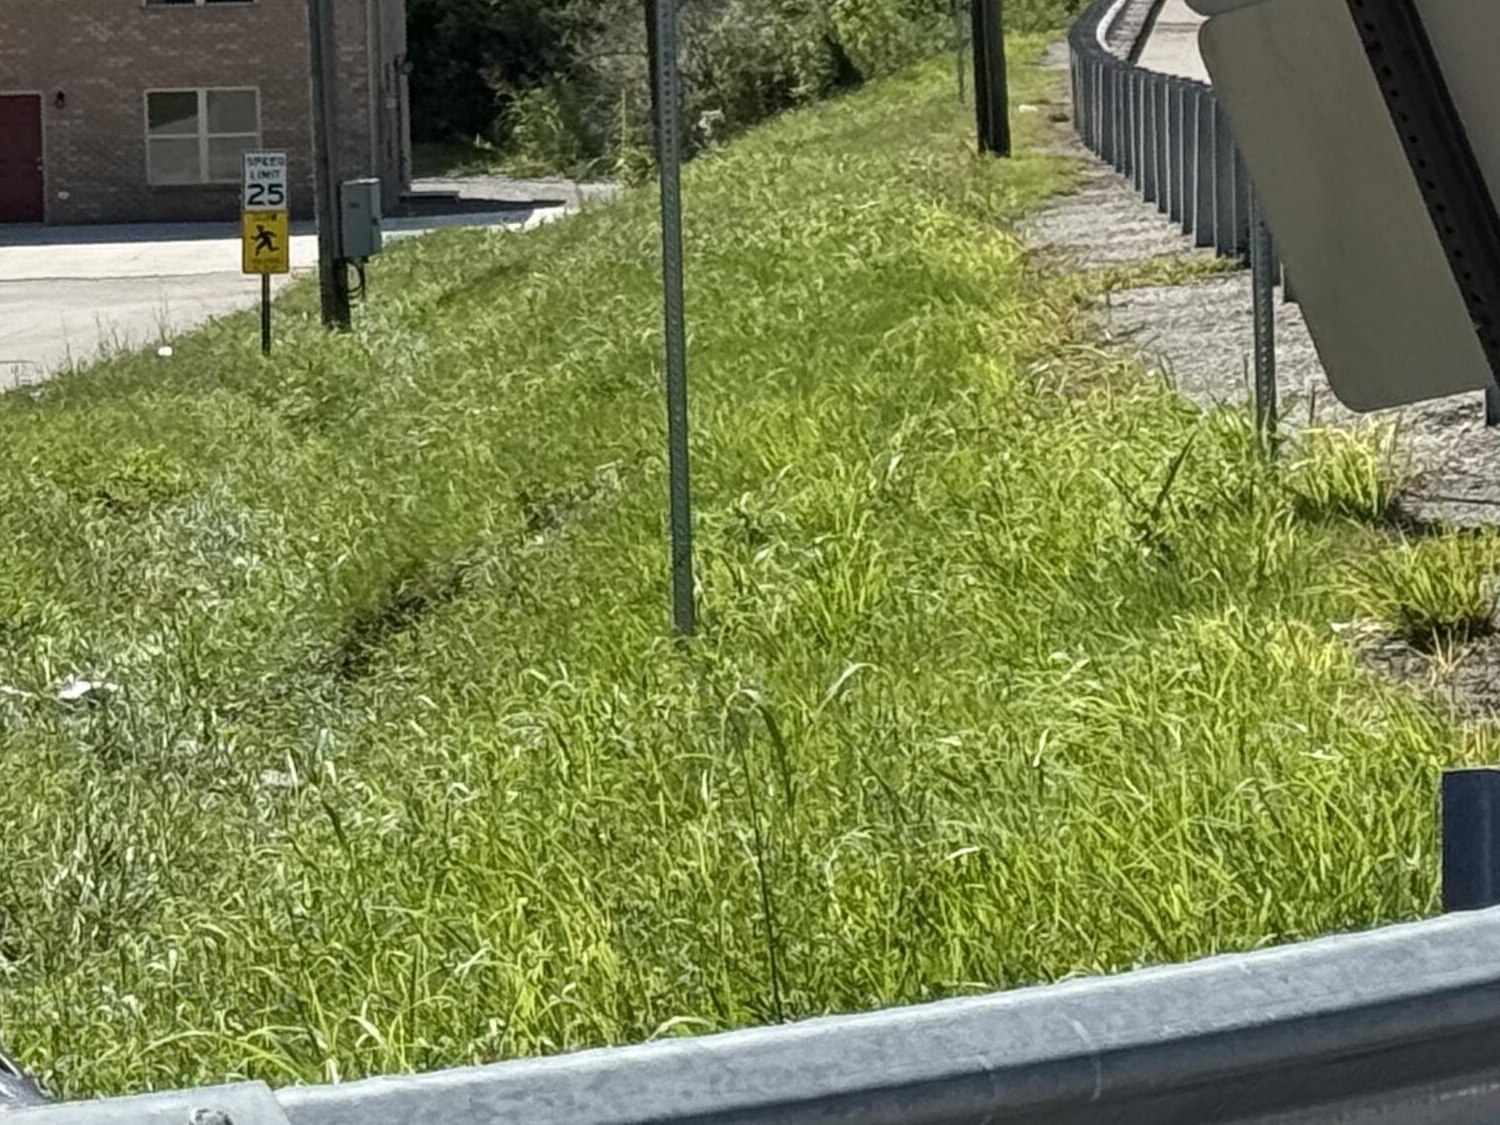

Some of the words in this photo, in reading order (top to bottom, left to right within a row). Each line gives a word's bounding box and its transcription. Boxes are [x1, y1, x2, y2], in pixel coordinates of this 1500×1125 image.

[247, 157, 285, 167] SPEED
[250, 169, 280, 180] LIMIT
[247, 183, 284, 205] 25
